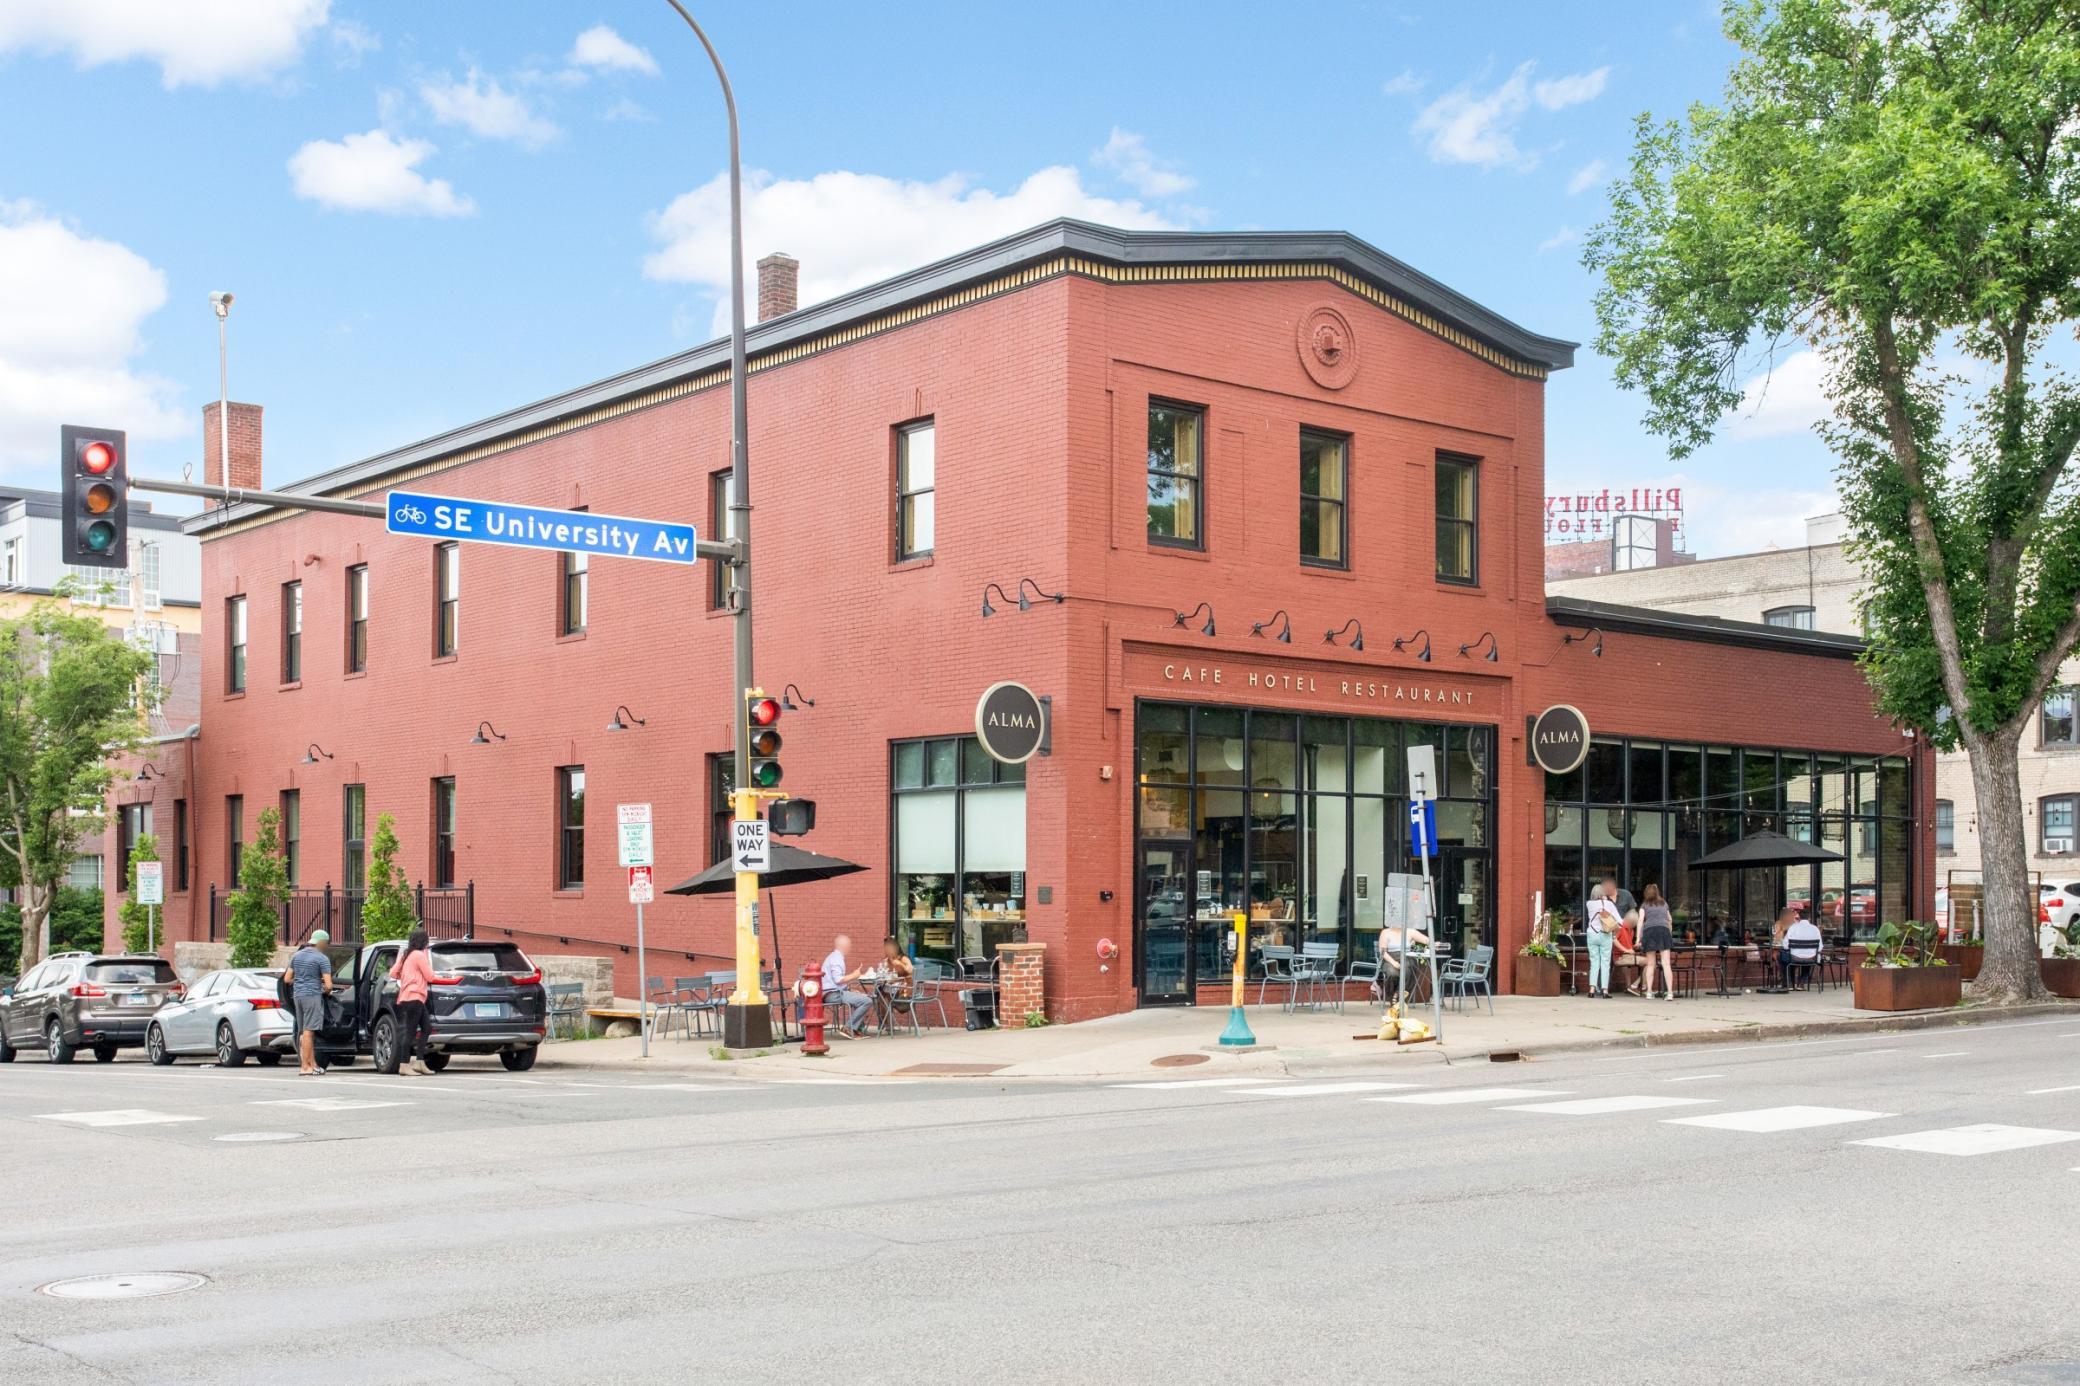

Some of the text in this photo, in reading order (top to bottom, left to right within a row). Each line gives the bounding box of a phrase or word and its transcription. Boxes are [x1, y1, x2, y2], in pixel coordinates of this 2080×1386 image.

[434, 505, 689, 555] SE University Av
[1165, 664, 1472, 705] CAFE HOTEL RESTAURANT
[988, 711, 1036, 729] ALMA
[1540, 730, 1579, 744] ALMA
[737, 824, 764, 836] ONE
[737, 839, 764, 851] WAY
